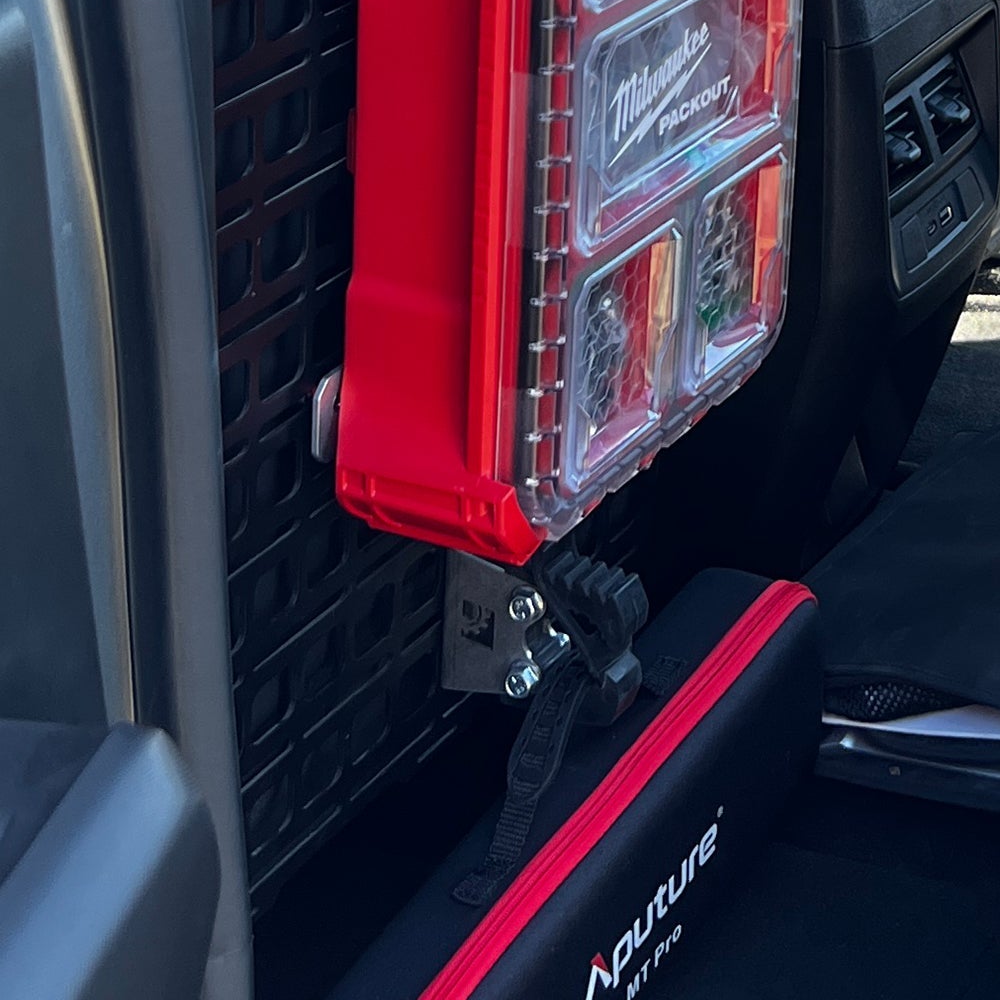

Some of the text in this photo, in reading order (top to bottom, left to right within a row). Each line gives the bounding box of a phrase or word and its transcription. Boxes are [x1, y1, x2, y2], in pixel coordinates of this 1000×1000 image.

[608, 22, 711, 143] Milwaukee
[658, 74, 732, 137] PACKOUT
[626, 923, 683, 1000] MT Pro
